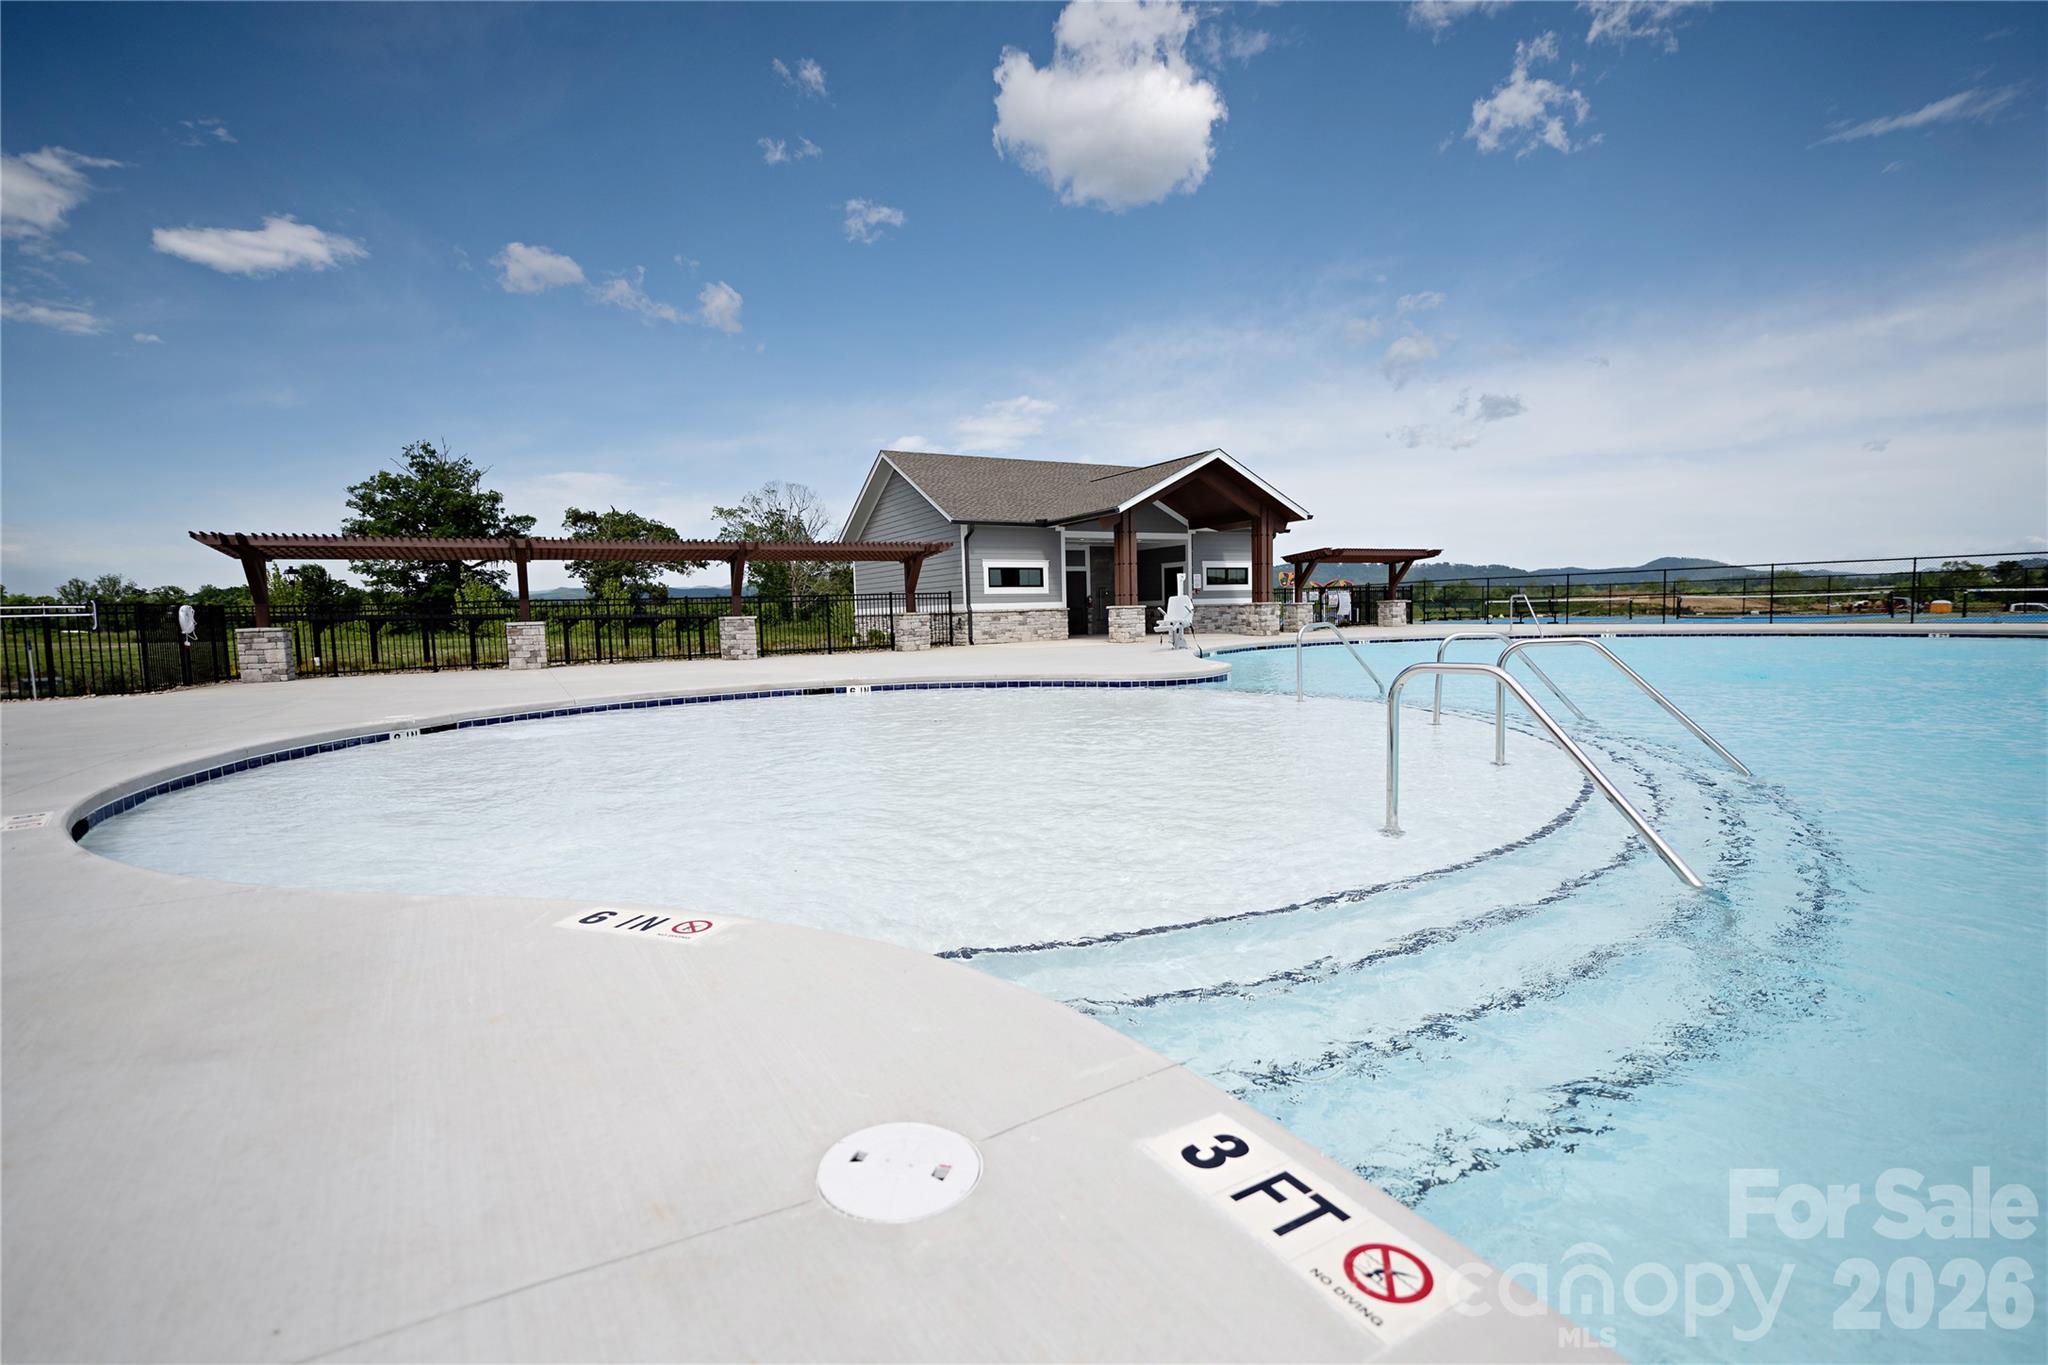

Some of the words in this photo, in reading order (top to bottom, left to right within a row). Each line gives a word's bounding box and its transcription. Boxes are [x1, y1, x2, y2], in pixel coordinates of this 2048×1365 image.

[578, 910, 618, 925] 6
[614, 914, 671, 932] IN
[1181, 1134, 1250, 1169] 3
[1230, 1171, 1351, 1237] FT
[1309, 1268, 1333, 1286] NO
[1333, 1286, 1384, 1327] DIVING
